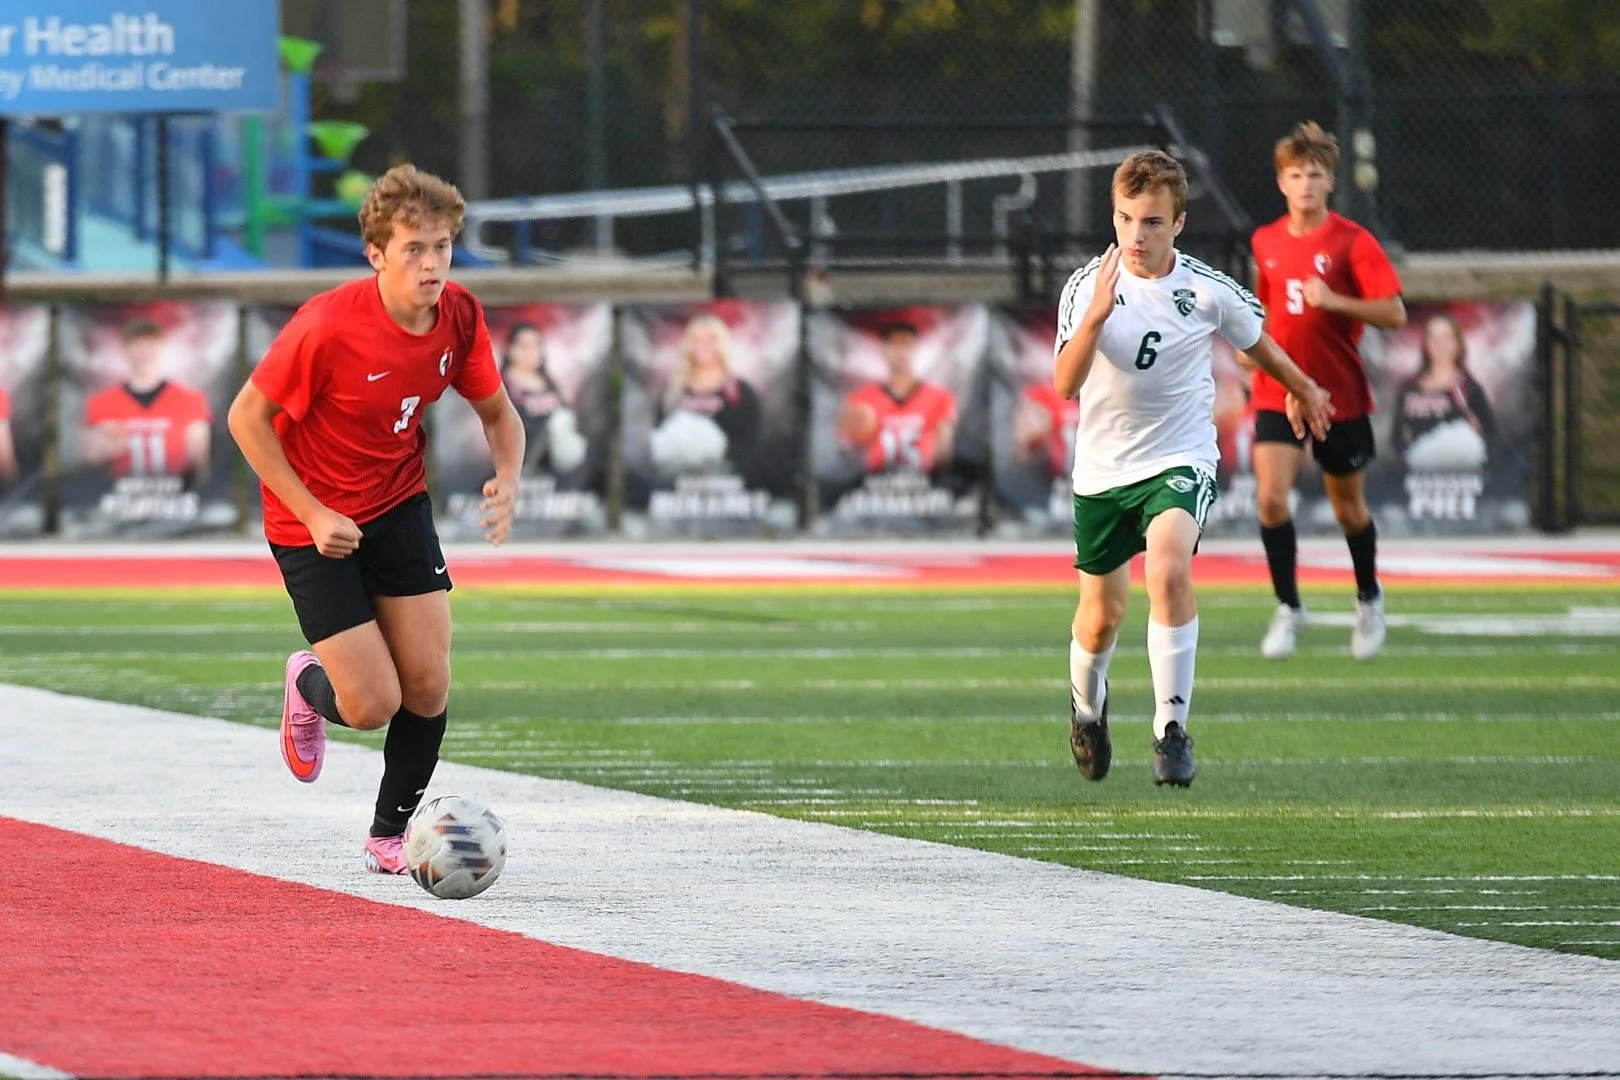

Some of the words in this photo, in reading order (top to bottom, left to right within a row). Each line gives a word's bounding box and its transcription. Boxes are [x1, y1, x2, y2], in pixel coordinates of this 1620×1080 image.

[24, 12, 175, 56] Health
[29, 61, 143, 91] Medical
[148, 61, 246, 91] Center
[1286, 278, 1304, 315] 5
[1135, 331, 1161, 370] 6
[393, 395, 421, 434] 3
